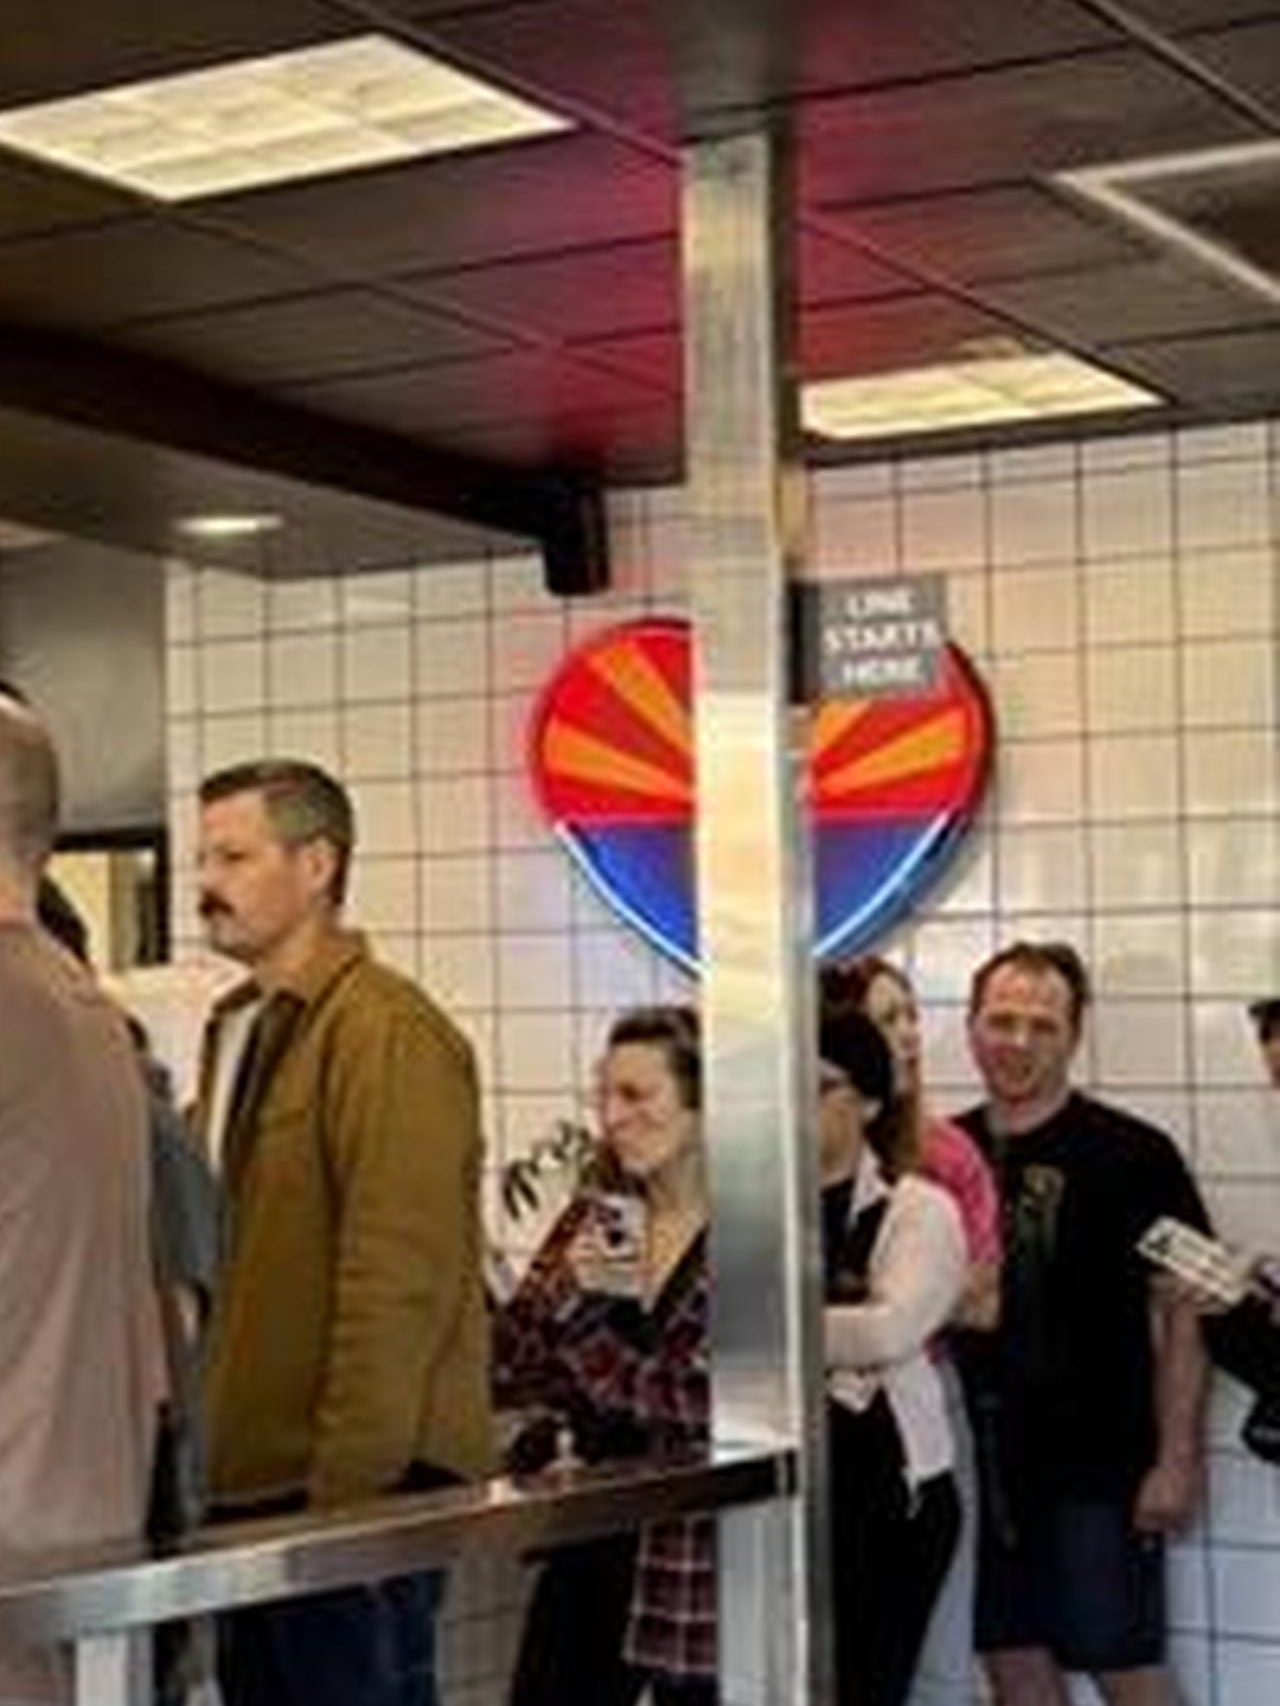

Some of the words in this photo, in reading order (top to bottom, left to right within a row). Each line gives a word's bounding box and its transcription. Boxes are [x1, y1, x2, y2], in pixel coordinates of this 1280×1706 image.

[845, 589, 911, 616] LINE
[823, 621, 940, 655] STARTS
[842, 658, 922, 685] HERE
